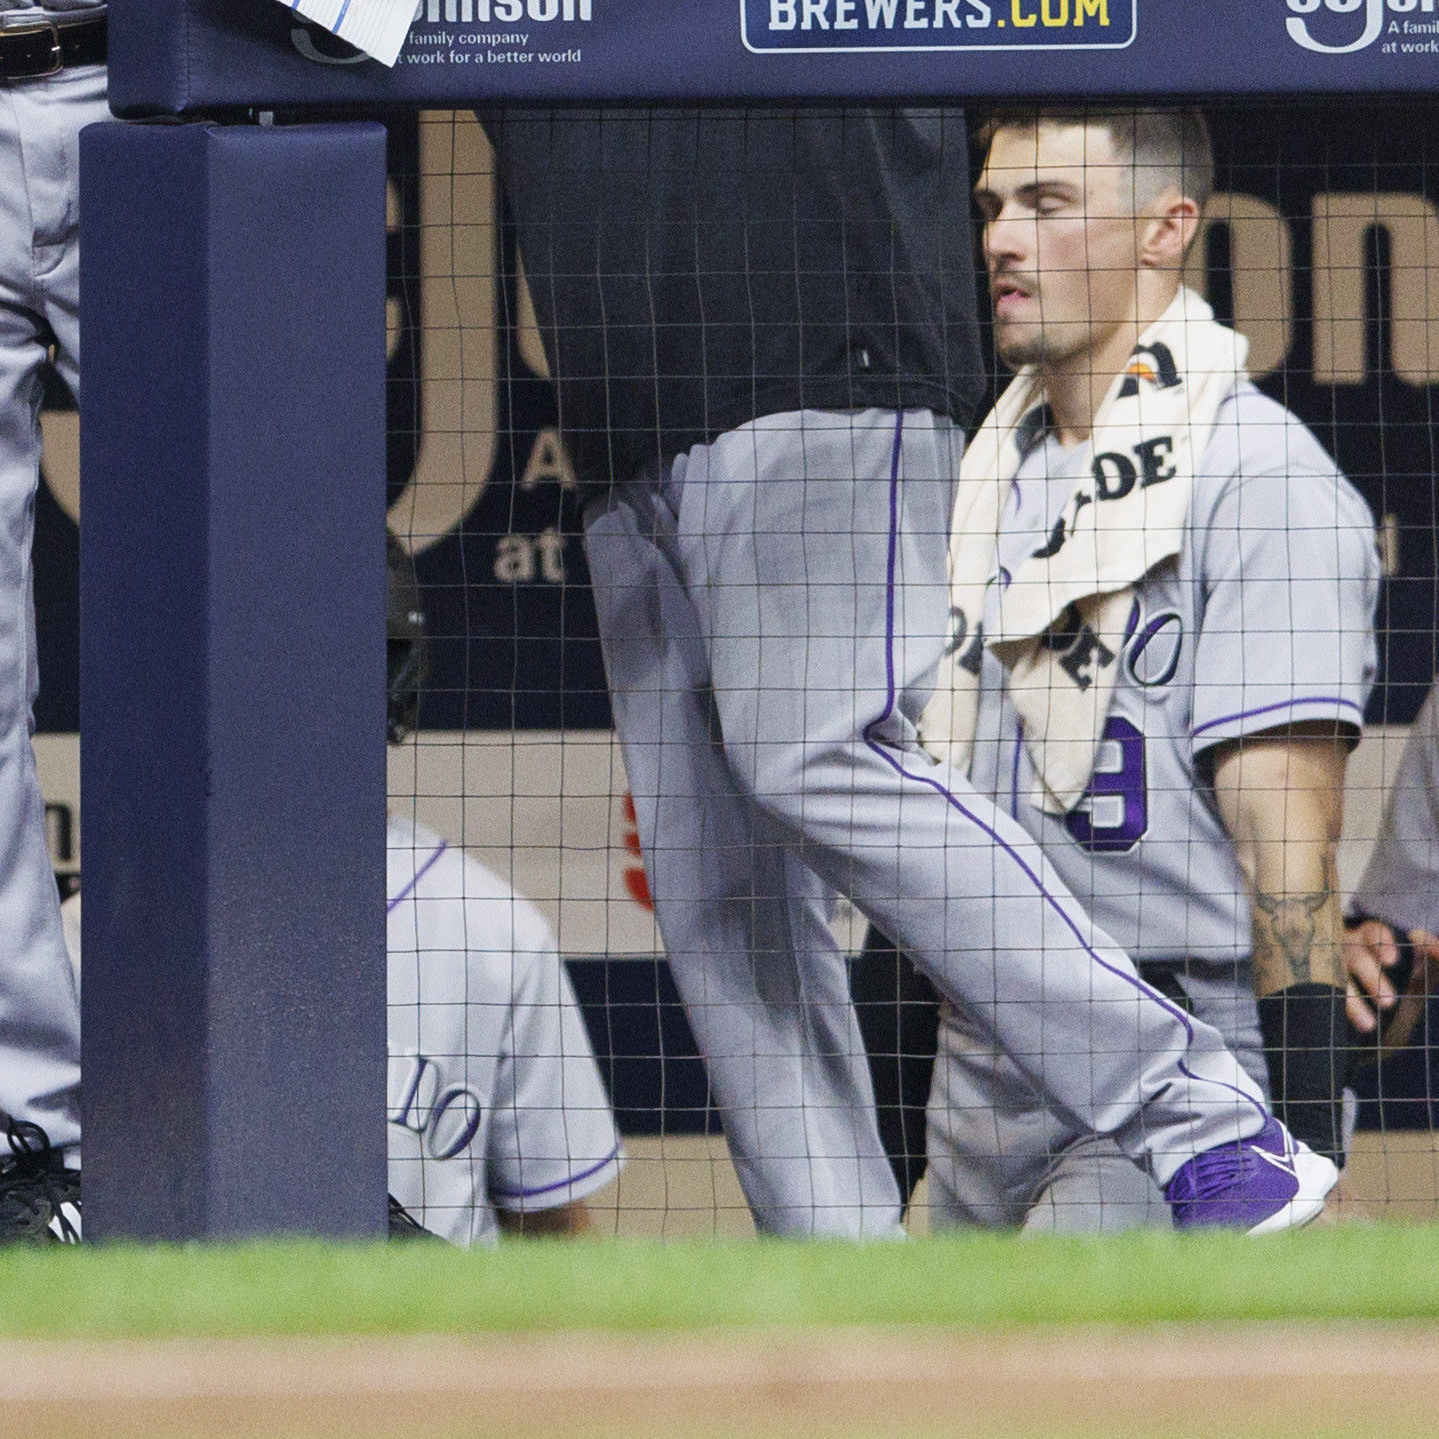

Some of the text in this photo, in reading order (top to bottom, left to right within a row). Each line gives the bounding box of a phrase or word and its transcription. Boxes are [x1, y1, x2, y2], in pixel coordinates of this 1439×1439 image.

[1387, 20, 1399, 34] A
[409, 30, 529, 48] family company
[1381, 41, 1397, 54] at
[406, 48, 582, 64] work for a better world
